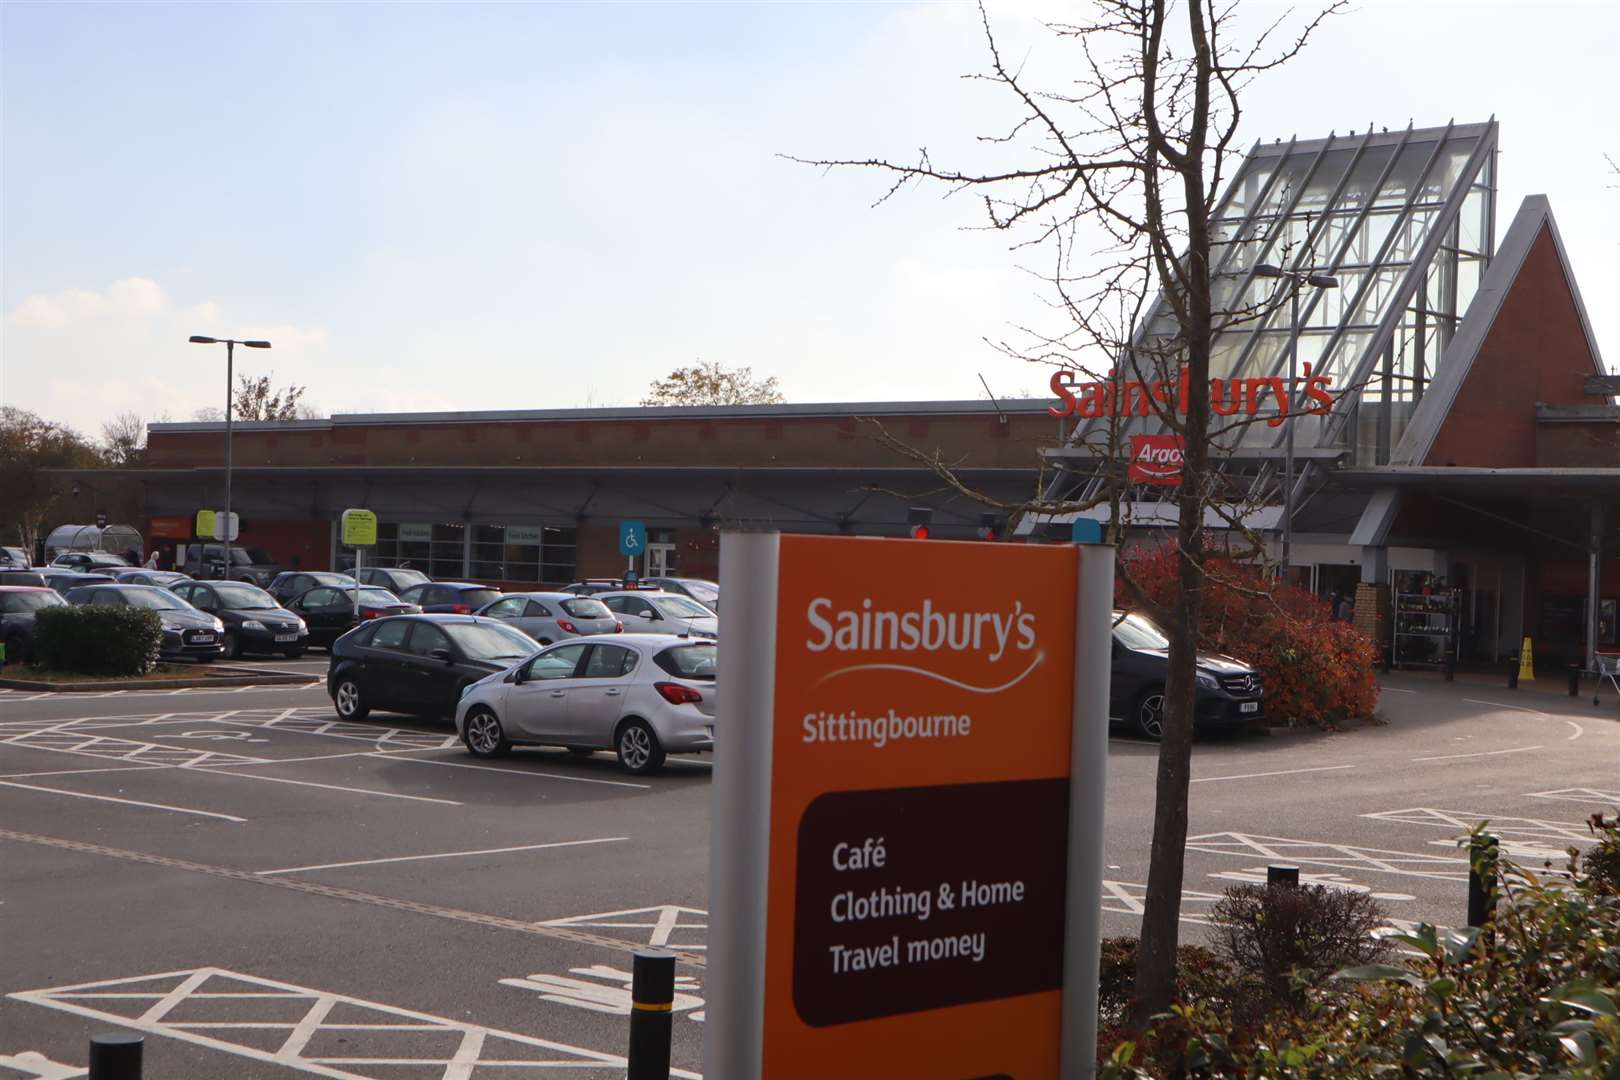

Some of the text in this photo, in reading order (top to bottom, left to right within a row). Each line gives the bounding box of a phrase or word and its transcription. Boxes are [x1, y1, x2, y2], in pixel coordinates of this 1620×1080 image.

[806, 597, 1035, 661] Sainsbury's
[803, 709, 971, 748] Sittingbourne
[832, 837, 886, 870] Café
[831, 880, 1025, 922] Clothing & Home
[829, 933, 985, 973] Travel money
